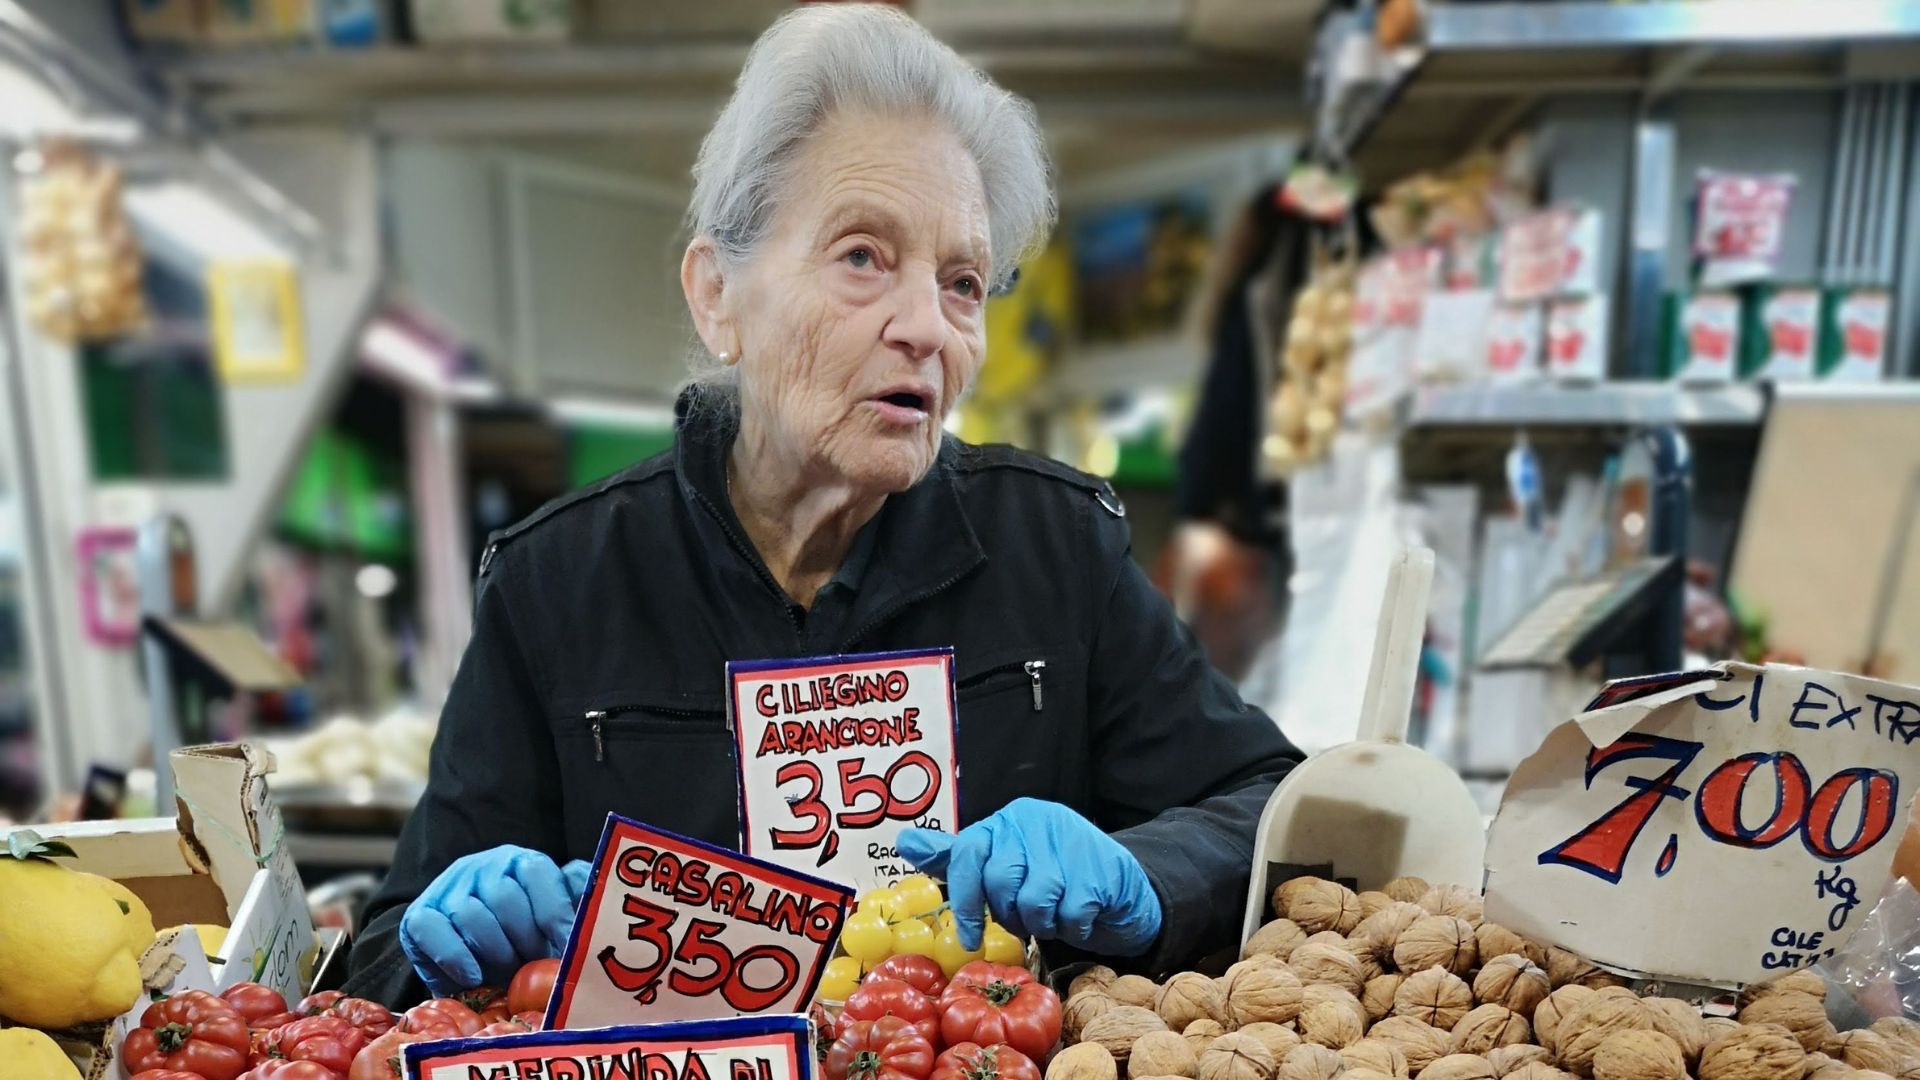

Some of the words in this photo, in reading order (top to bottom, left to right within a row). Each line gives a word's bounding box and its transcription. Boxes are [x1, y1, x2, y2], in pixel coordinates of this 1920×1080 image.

[756, 670, 909, 717] CILIEGINO
[756, 708, 922, 758] ARANCIONE
[769, 750, 942, 867] 3,50
[1538, 732, 1899, 885] 7,00
[616, 845, 840, 943] CASALINO
[1814, 865, 1861, 932] Kg
[597, 893, 800, 1012] 3,50
